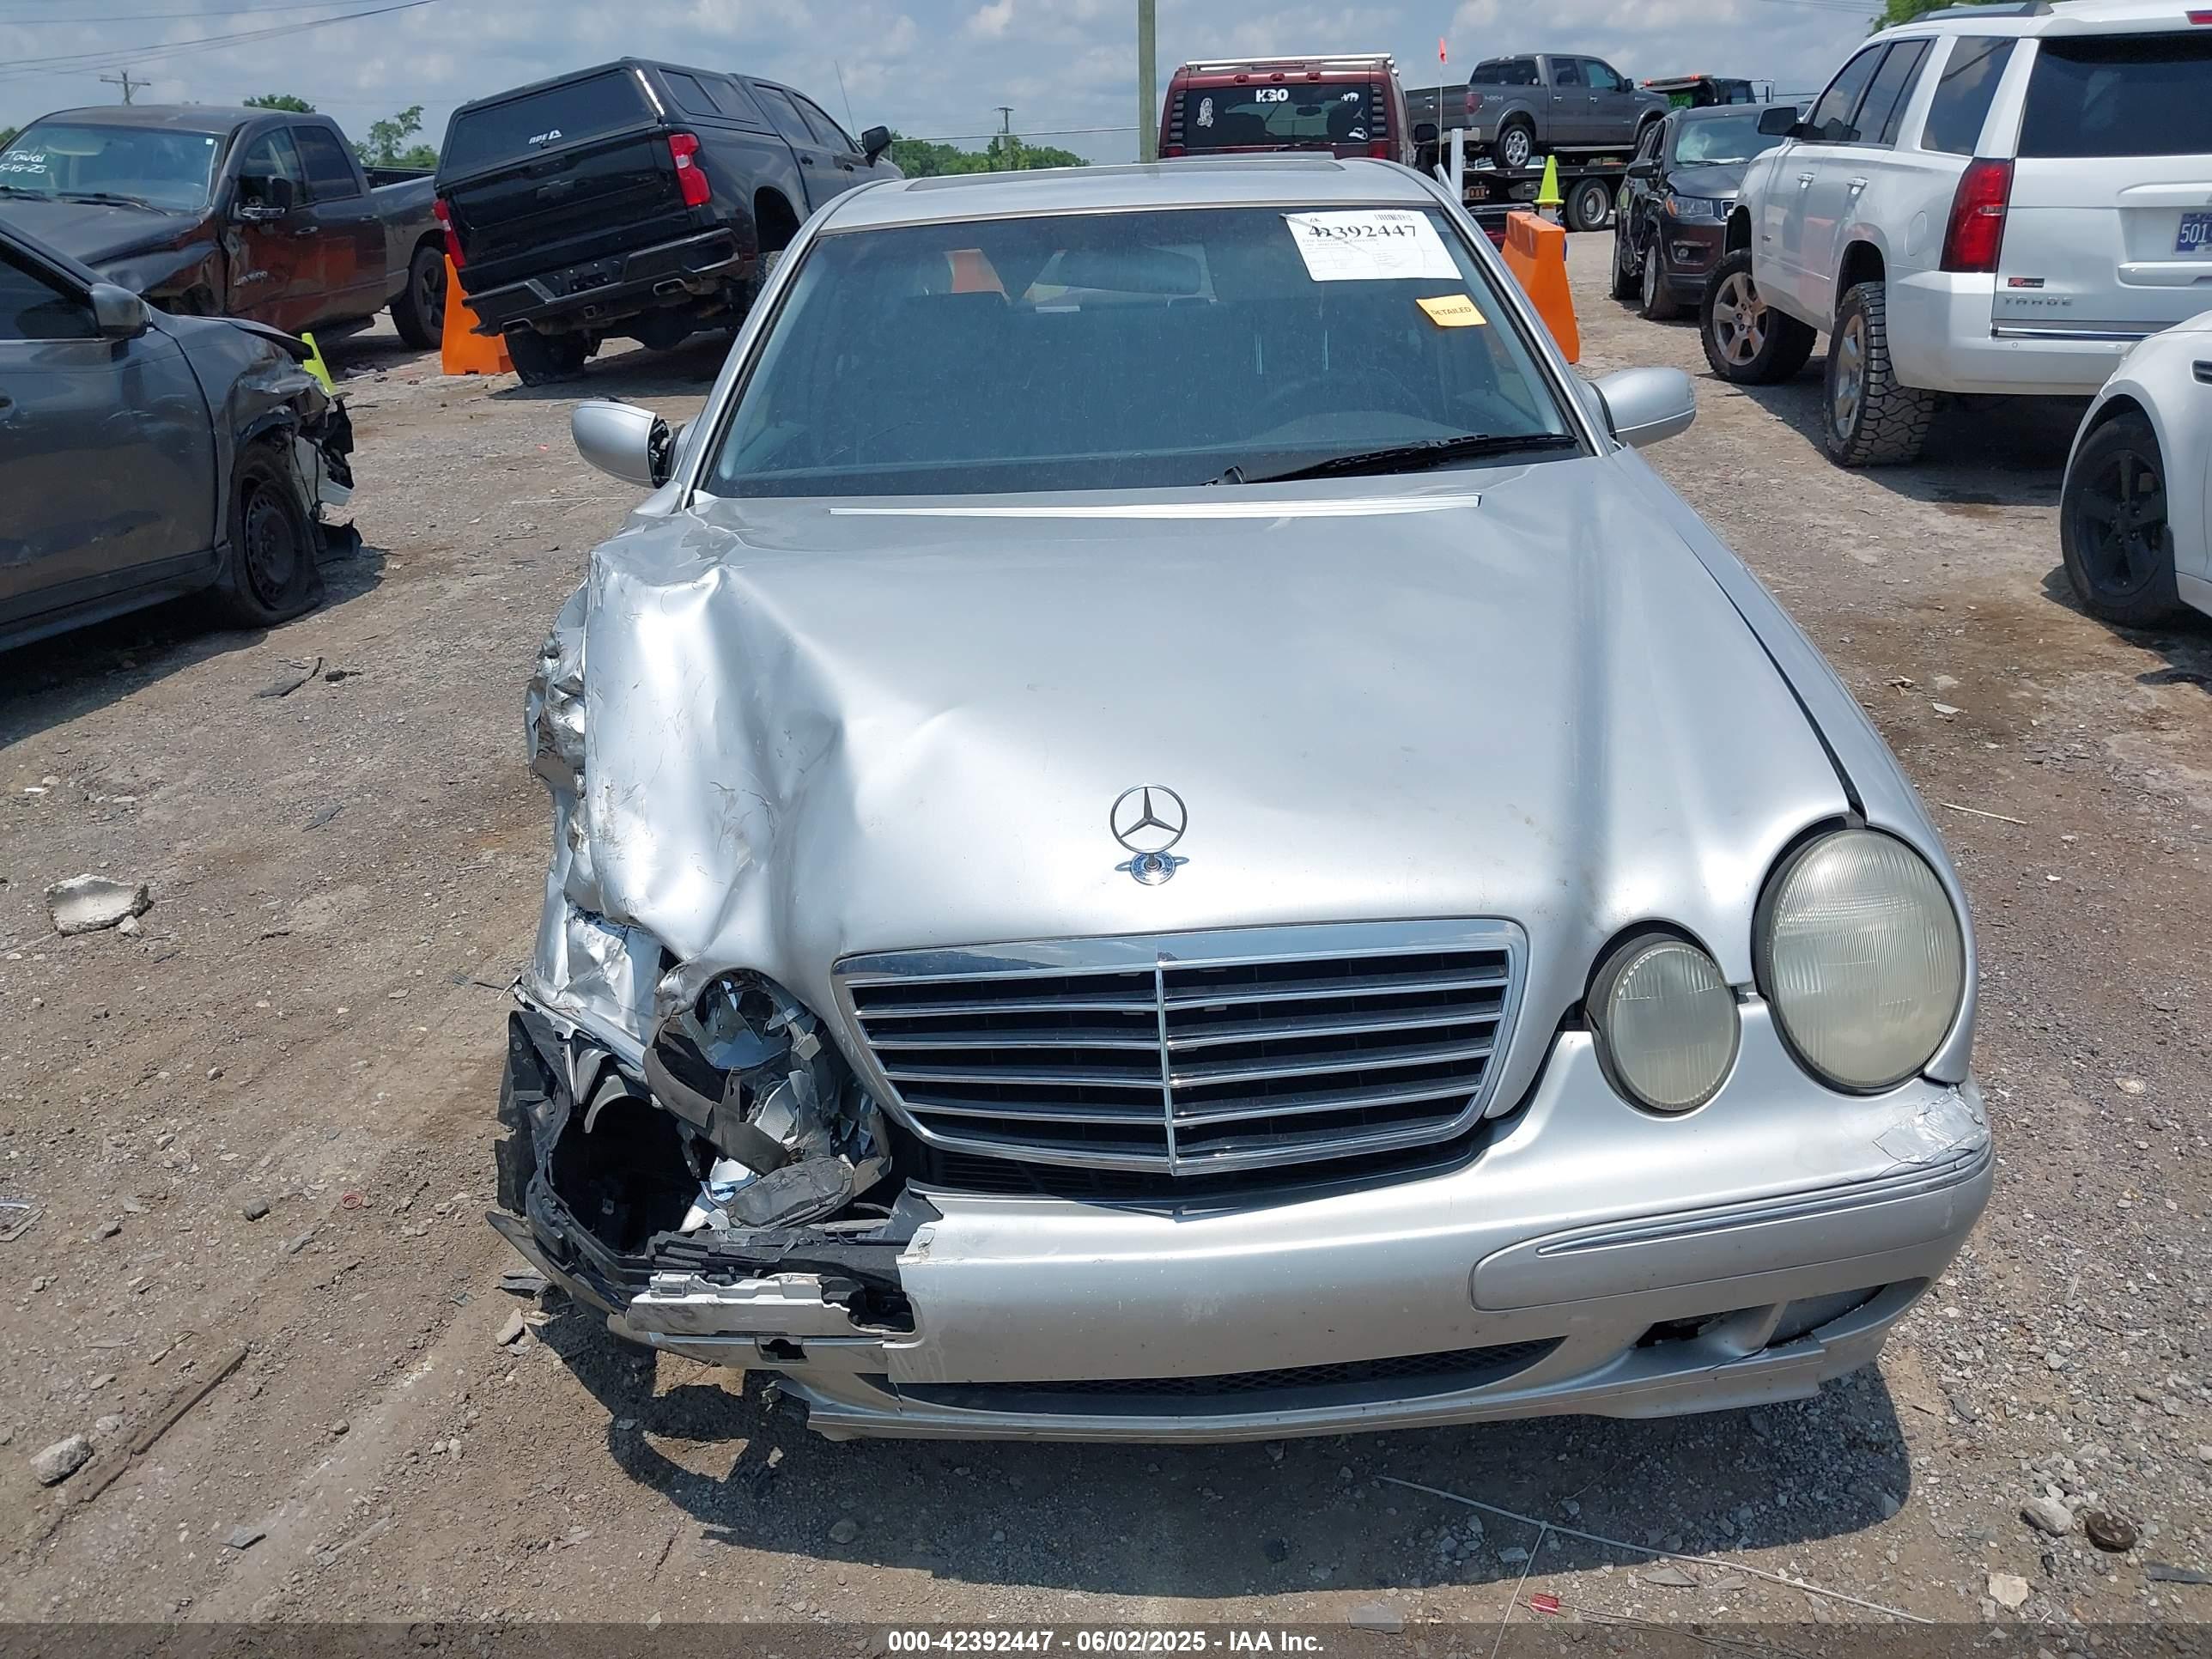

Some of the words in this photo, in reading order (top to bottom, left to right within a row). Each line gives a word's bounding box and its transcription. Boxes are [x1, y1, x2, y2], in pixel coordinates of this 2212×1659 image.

[1309, 224, 1416, 240] 42392447
[2005, 295, 2074, 306] TAHOE
[1430, 307, 1472, 316] DETAILED
